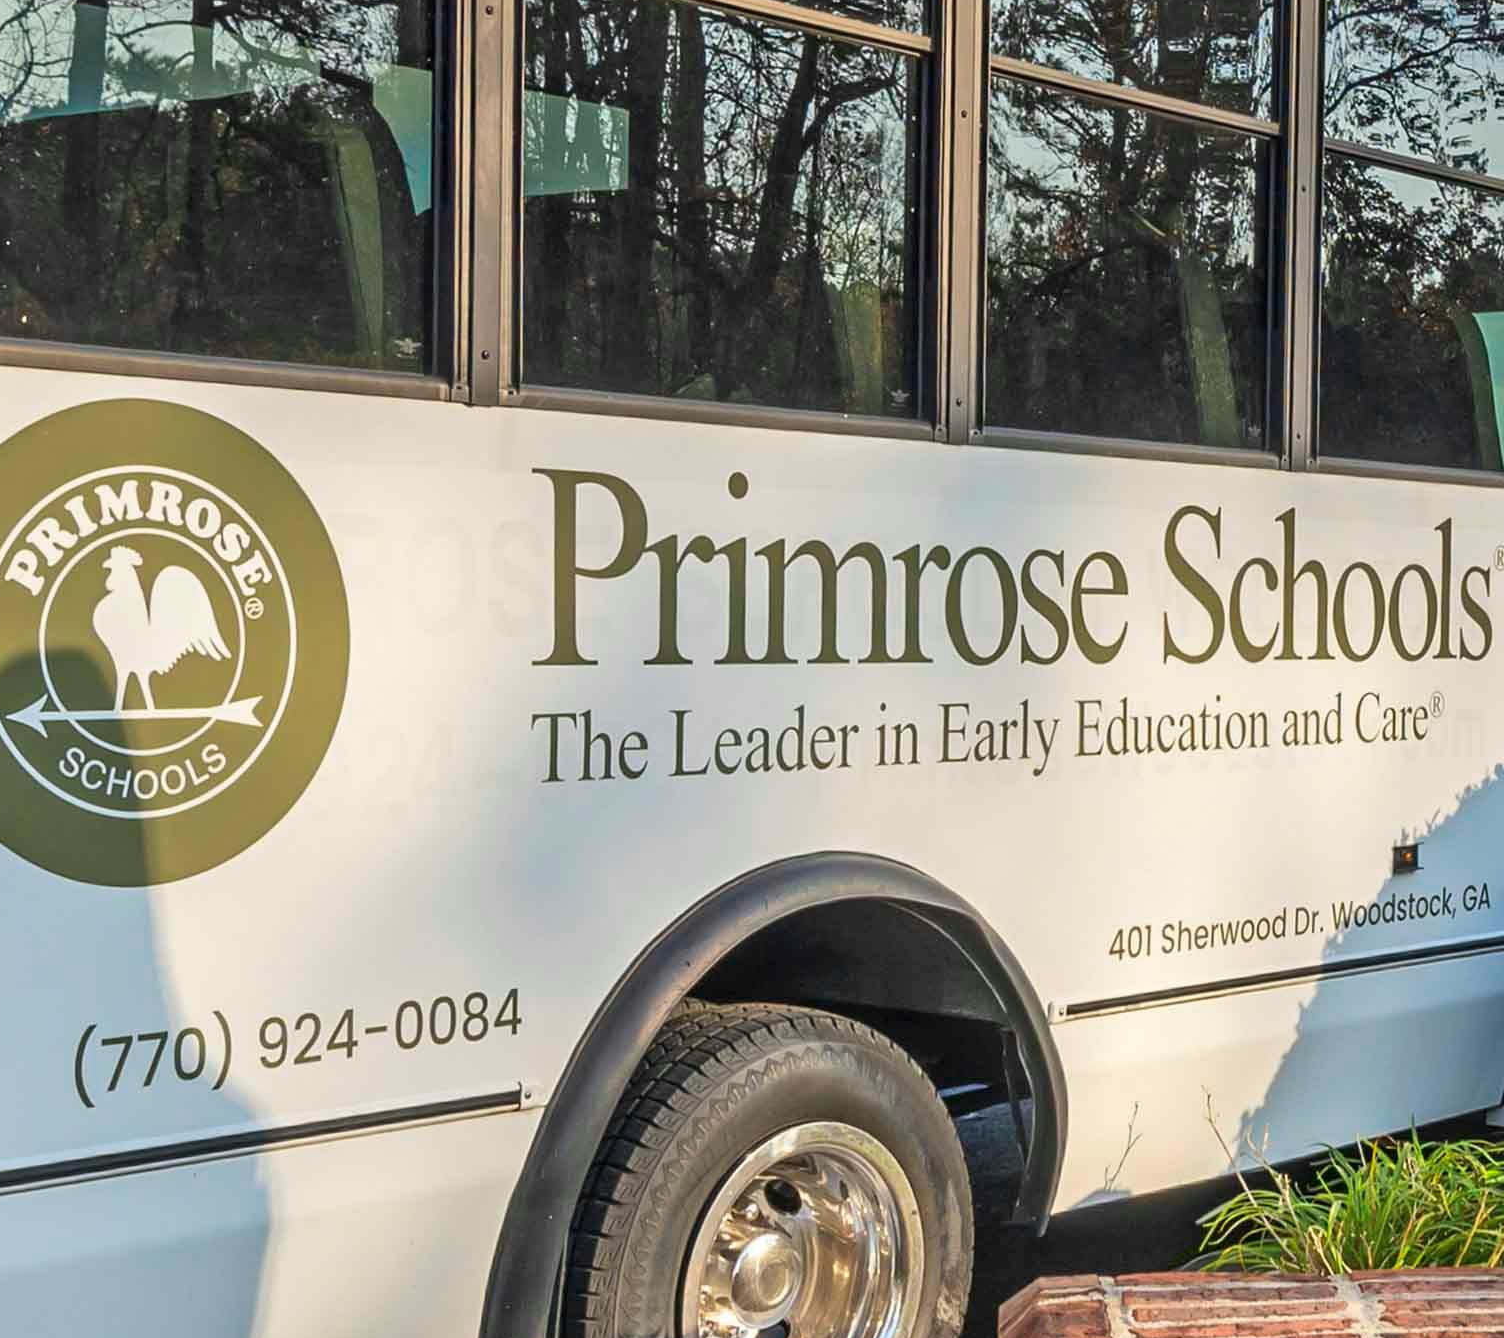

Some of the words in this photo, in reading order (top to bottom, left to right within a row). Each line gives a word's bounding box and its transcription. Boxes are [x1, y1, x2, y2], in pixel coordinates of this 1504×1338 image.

[531, 467, 1129, 667] Primrose
[58, 743, 227, 800] SCHOOLS
[531, 709, 649, 783] The
[668, 704, 859, 777] Leader
[874, 702, 921, 767] in
[936, 698, 1060, 777] Early
[1074, 694, 1271, 757] Education
[1281, 692, 1343, 746] and
[1109, 924, 1152, 961] 401
[1161, 907, 1286, 954] Sherwood
[1294, 905, 1324, 936] Dr.
[1332, 887, 1457, 931] Woodstock,
[1462, 882, 1491, 912] GA
[74, 1010, 233, 1108] (770)
[258, 988, 523, 1070] 924-0084
